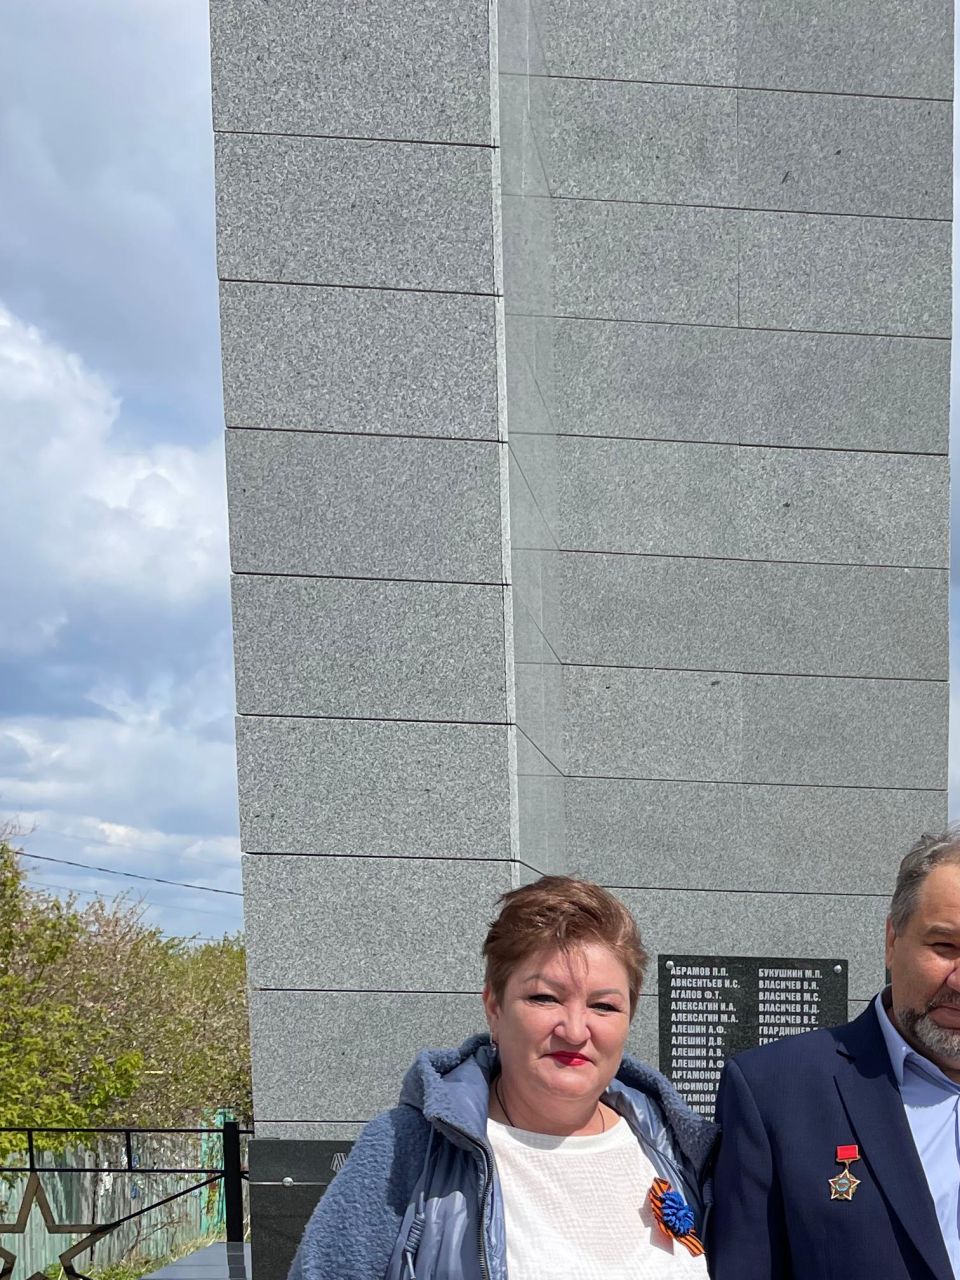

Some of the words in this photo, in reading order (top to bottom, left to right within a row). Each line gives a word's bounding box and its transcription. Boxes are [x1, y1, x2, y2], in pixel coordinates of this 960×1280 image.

[671, 967, 710, 976] АБРАМОВ
[713, 968, 729, 976] П.П.
[759, 969, 803, 978] БУКУШКИН
[805, 970, 823, 978] М.П.
[671, 978, 723, 988] АВКСЕНТЬЕВ
[725, 979, 741, 988] И.С.
[759, 980, 801, 989] ВЛАСИЧЕВ
[804, 981, 819, 990] В.Я.
[671, 990, 702, 999] АГАПОВ
[704, 991, 722, 999] Ф.Т.
[759, 992, 801, 1001] ВЛАСИЧЕВ
[804, 993, 821, 1002] М.С.
[671, 1002, 718, 1011] АЛЕКСАГИН
[721, 1003, 737, 1011] И.А.
[759, 1003, 801, 1012] ВЛАСИЧЕВ
[804, 1004, 820, 1014] Я.Д.
[671, 1013, 719, 1022] АЛЕКСАГИН
[721, 1014, 739, 1023] М.А.
[759, 1015, 801, 1024] ВЛАСИЧЕВ
[804, 1016, 819, 1024] В.Е.
[671, 1025, 706, 1034] АЛЕШИН
[708, 1025, 727, 1034] А.Ф.
[671, 1036, 706, 1045] АЛЕШИН
[708, 1037, 725, 1046] Д.В.
[672, 1048, 706, 1056] АЛЕШИН
[709, 1048, 725, 1057] А.В.
[672, 1059, 706, 1068] АЛЕШИН
[709, 1060, 725, 1068] А.Ф
[672, 1071, 721, 1079] АРТАМОНОВ
